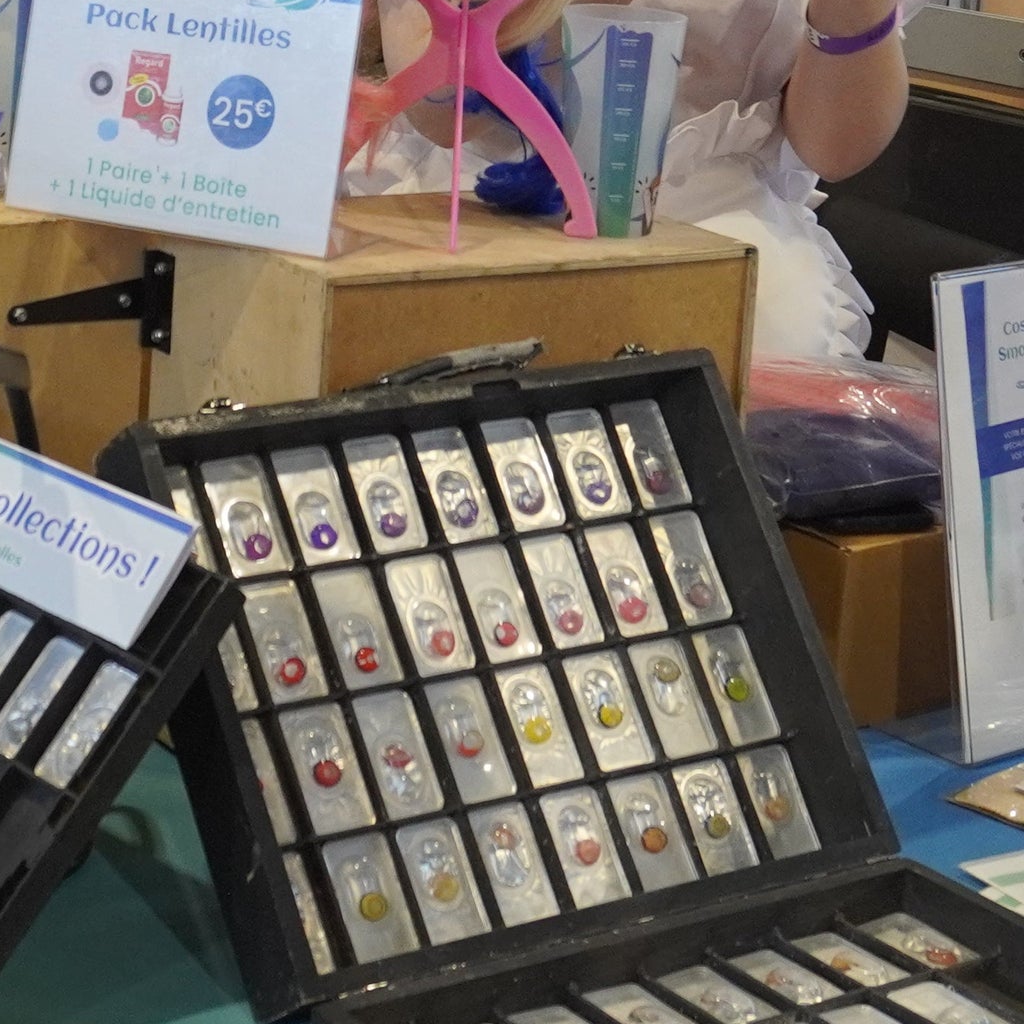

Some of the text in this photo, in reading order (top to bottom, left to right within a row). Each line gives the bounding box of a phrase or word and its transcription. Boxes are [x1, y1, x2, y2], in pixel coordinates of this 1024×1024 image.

[87, 3, 291, 49] Pack Lentilles
[212, 96, 272, 128] 25€
[87, 158, 93, 174] 1
[100, 160, 152, 183] Paire
[181, 172, 186, 189] 1
[82, 183, 156, 209] Liquide
[138, 556, 159, 588] !
